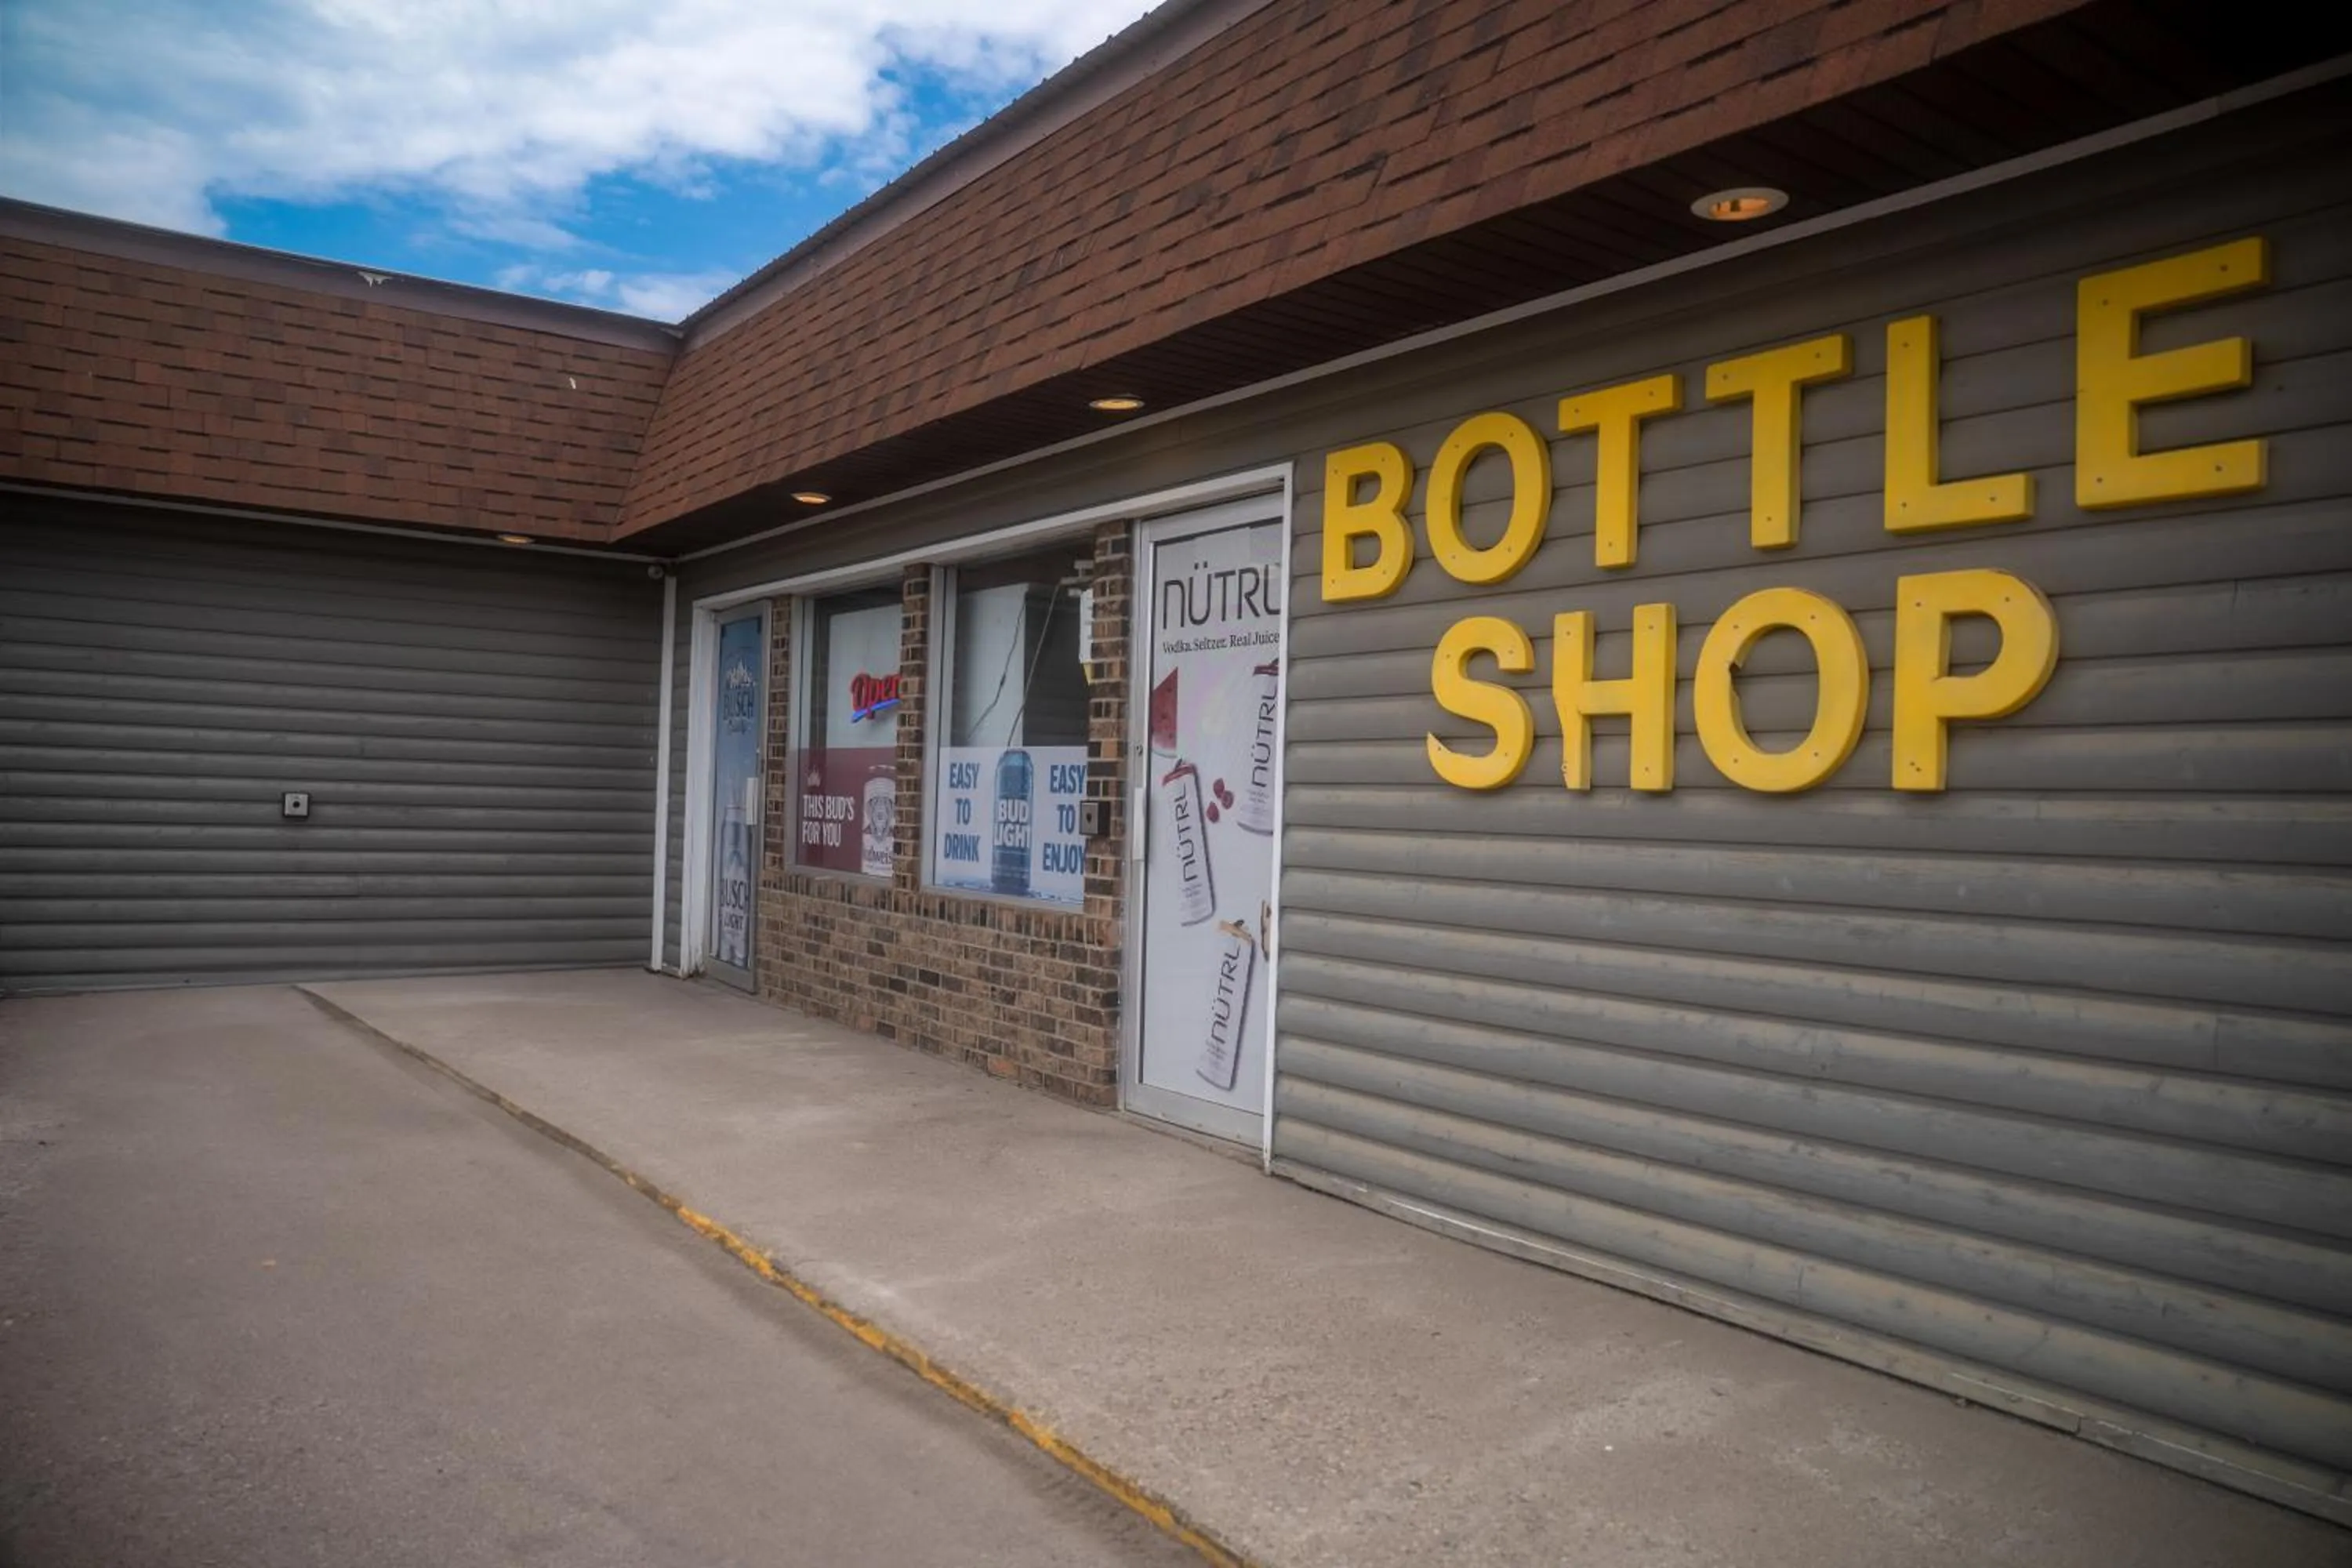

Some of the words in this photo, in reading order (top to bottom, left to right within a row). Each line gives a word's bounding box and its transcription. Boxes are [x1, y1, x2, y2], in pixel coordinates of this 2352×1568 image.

[1321, 235, 2272, 602] BOTTLE
[1229, 632, 1251, 648] Real
[1426, 568, 2060, 793] SHOP
[949, 761, 980, 789] EASY
[1049, 764, 1087, 795] EASY
[802, 793, 824, 819] THIS
[826, 794, 855, 821] BUD'S
[955, 797, 972, 826] TO
[998, 798, 1029, 823] BUD
[1056, 804, 1076, 834] TO
[802, 820, 821, 845] FOR
[822, 821, 842, 848] YOU
[943, 832, 980, 863] DRINK
[994, 822, 1031, 849] LIGHT
[1042, 842, 1087, 876] ENJOY
